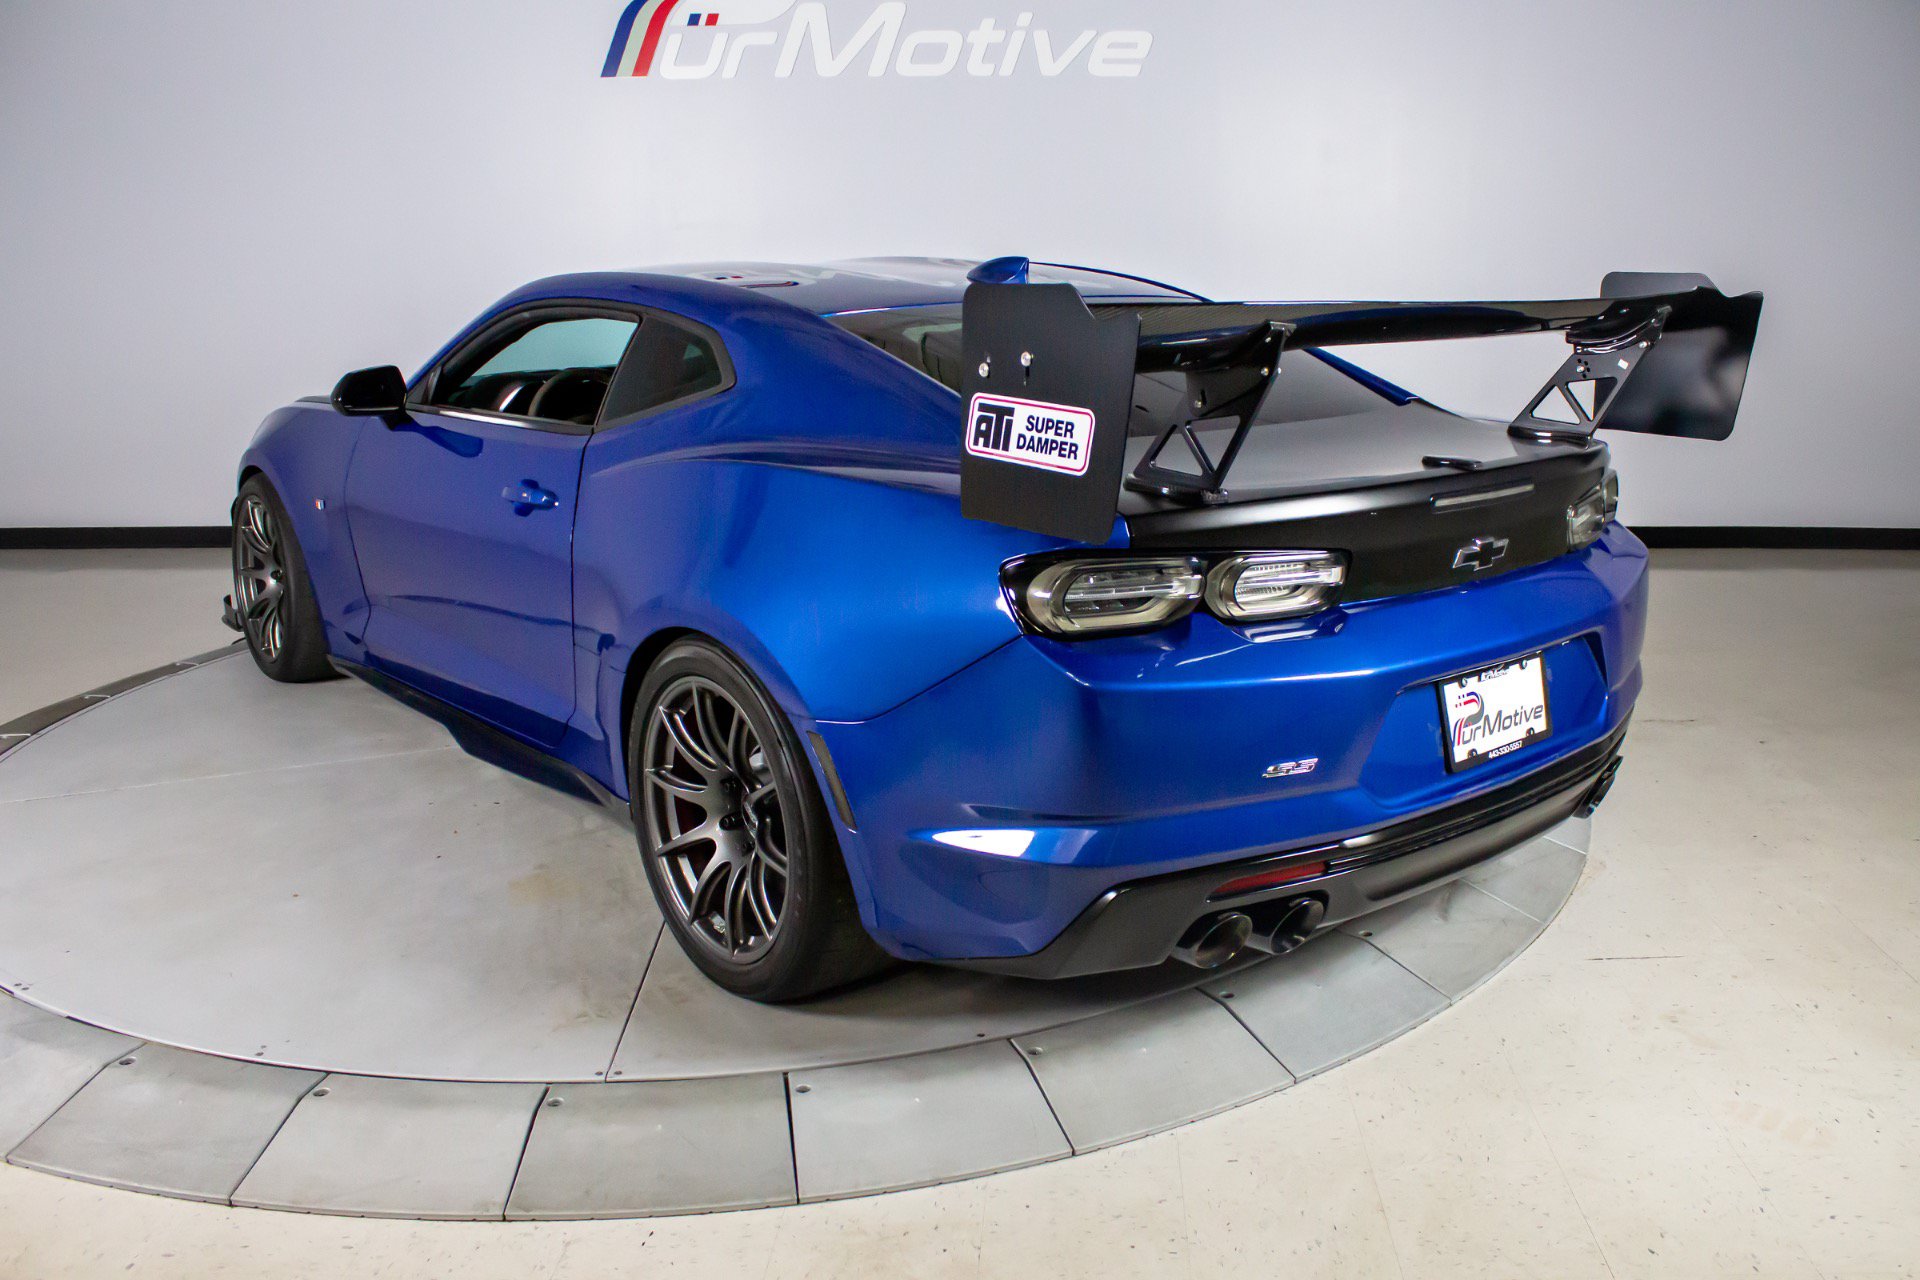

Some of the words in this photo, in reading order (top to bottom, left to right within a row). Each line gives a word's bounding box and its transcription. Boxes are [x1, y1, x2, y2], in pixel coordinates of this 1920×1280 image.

[972, 402, 1015, 452] ATI
[1025, 414, 1075, 439] SUPER
[1016, 433, 1079, 460] DAMPER
